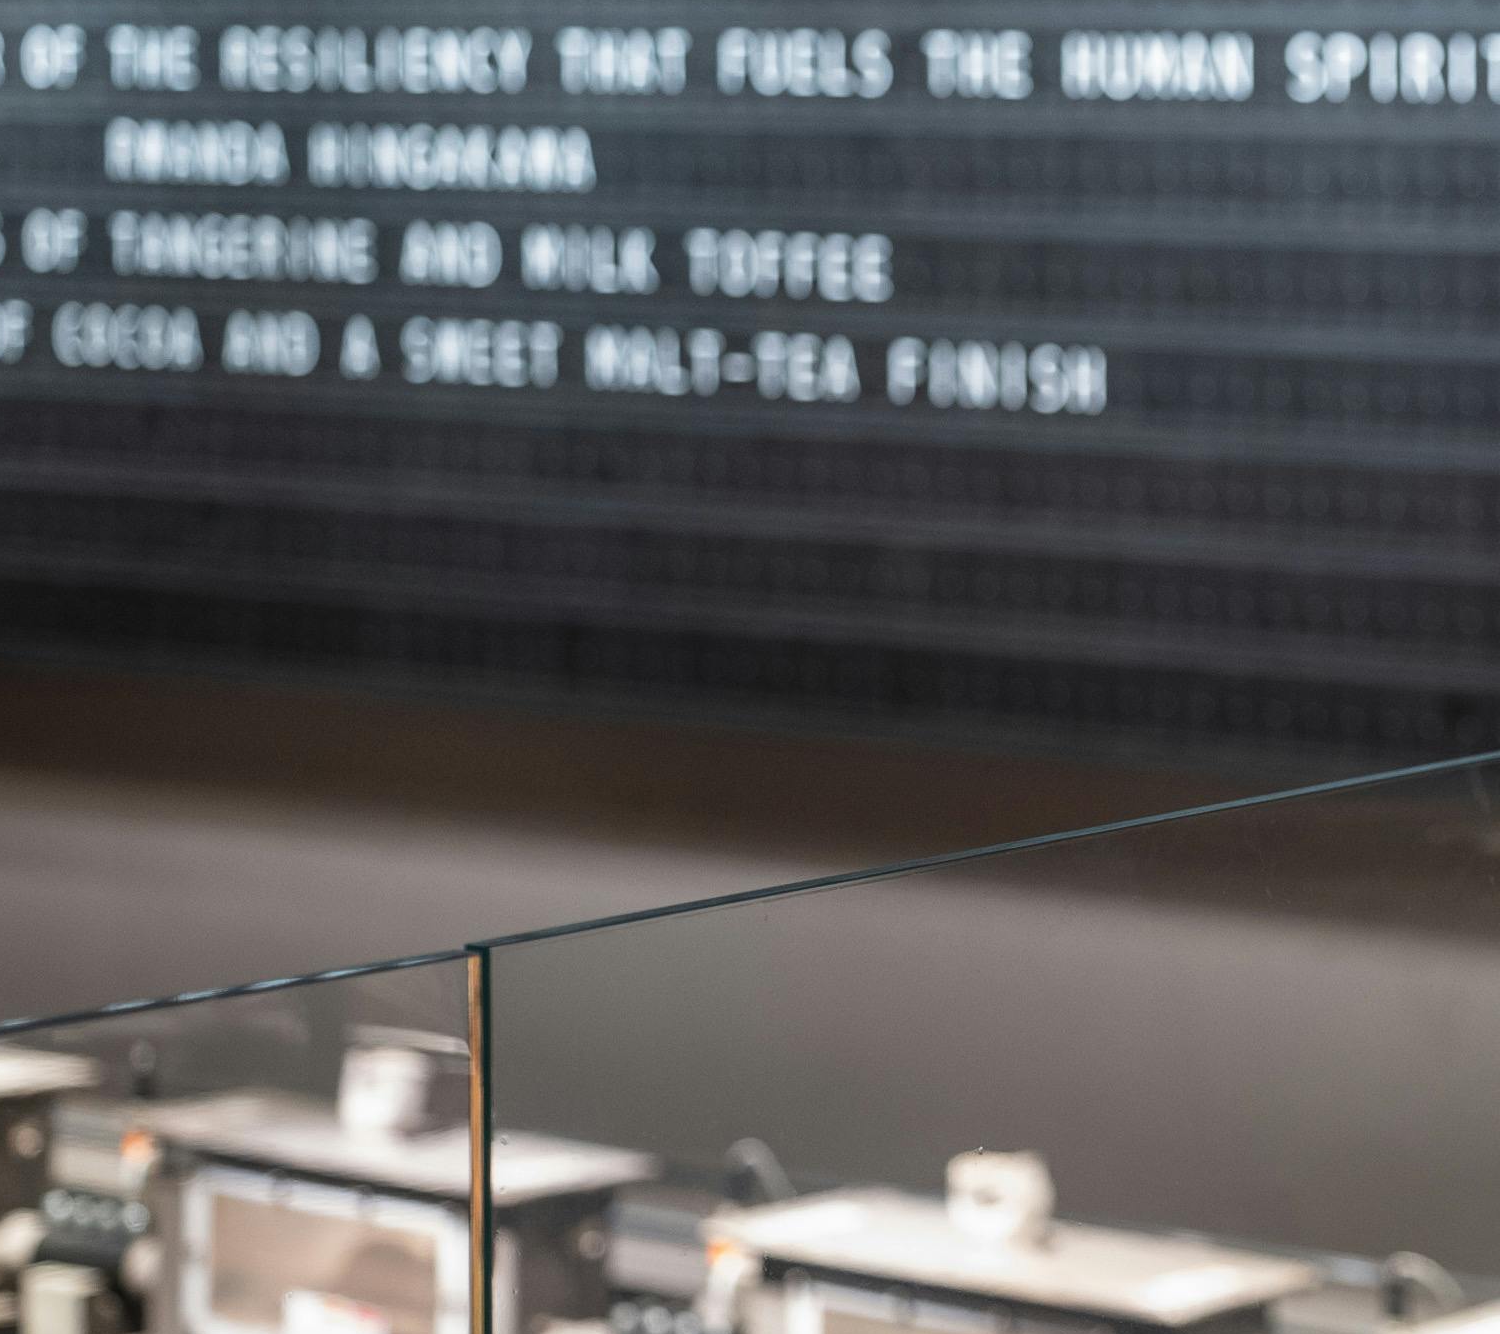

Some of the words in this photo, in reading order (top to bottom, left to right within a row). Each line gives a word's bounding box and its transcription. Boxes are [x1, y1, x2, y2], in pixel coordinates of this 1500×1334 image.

[21, 24, 81, 88] OF
[108, 24, 195, 91] THE
[221, 26, 531, 94] RESILIENCY
[558, 27, 688, 91] THAT
[717, 27, 892, 98] FUELS
[925, 30, 1030, 99] THE
[1062, 33, 1253, 99] HUMAN
[23, 208, 83, 272] OF
[110, 210, 374, 284] TANGERINE
[401, 222, 501, 287] AND
[521, 226, 657, 293] MILK
[687, 228, 890, 302] TOFFEE
[51, 302, 202, 372] COCOA
[223, 311, 319, 376] AND
[340, 315, 379, 377] A
[402, 317, 559, 387] SWEET
[585, 327, 859, 401] MALT-TEA
[888, 337, 1106, 413] FINISH
